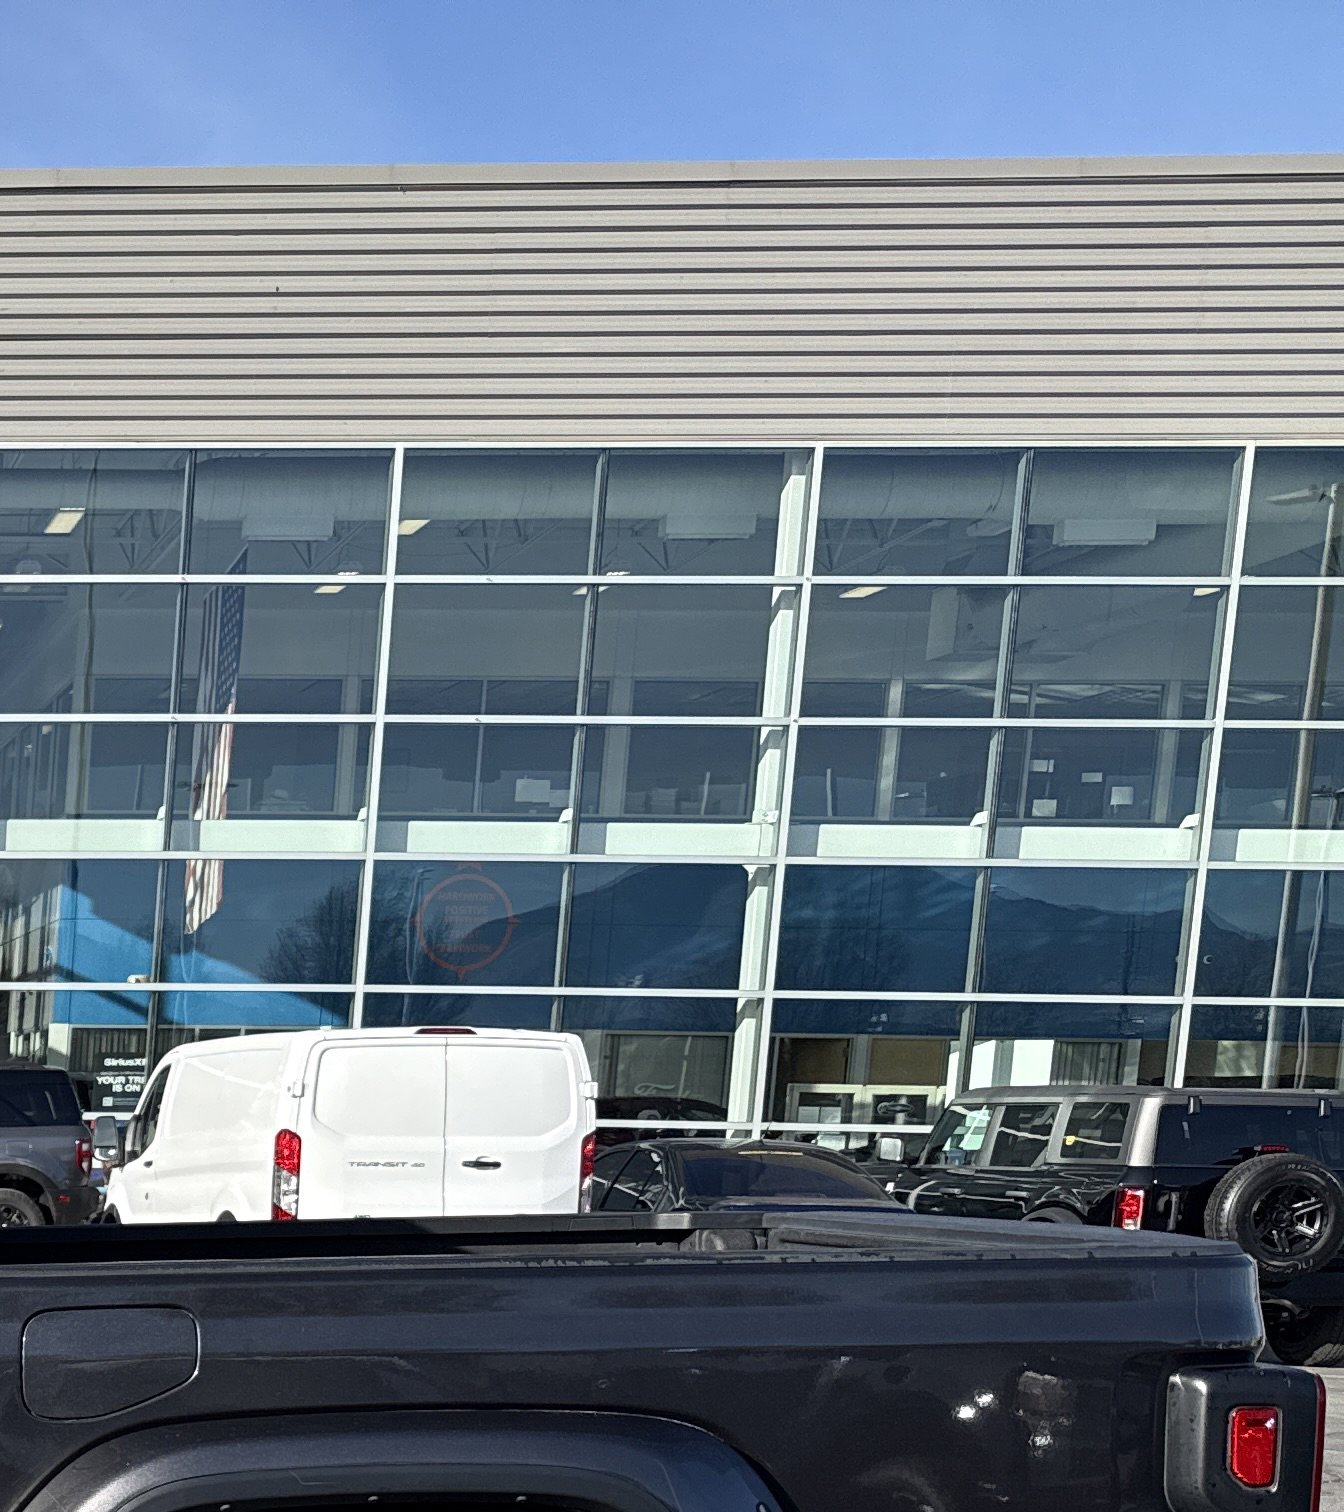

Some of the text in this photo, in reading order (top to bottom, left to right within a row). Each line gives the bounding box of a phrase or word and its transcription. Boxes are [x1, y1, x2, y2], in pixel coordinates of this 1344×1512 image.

[96, 1076, 125, 1084] YOUR
[112, 1084, 140, 1092] IS ON
